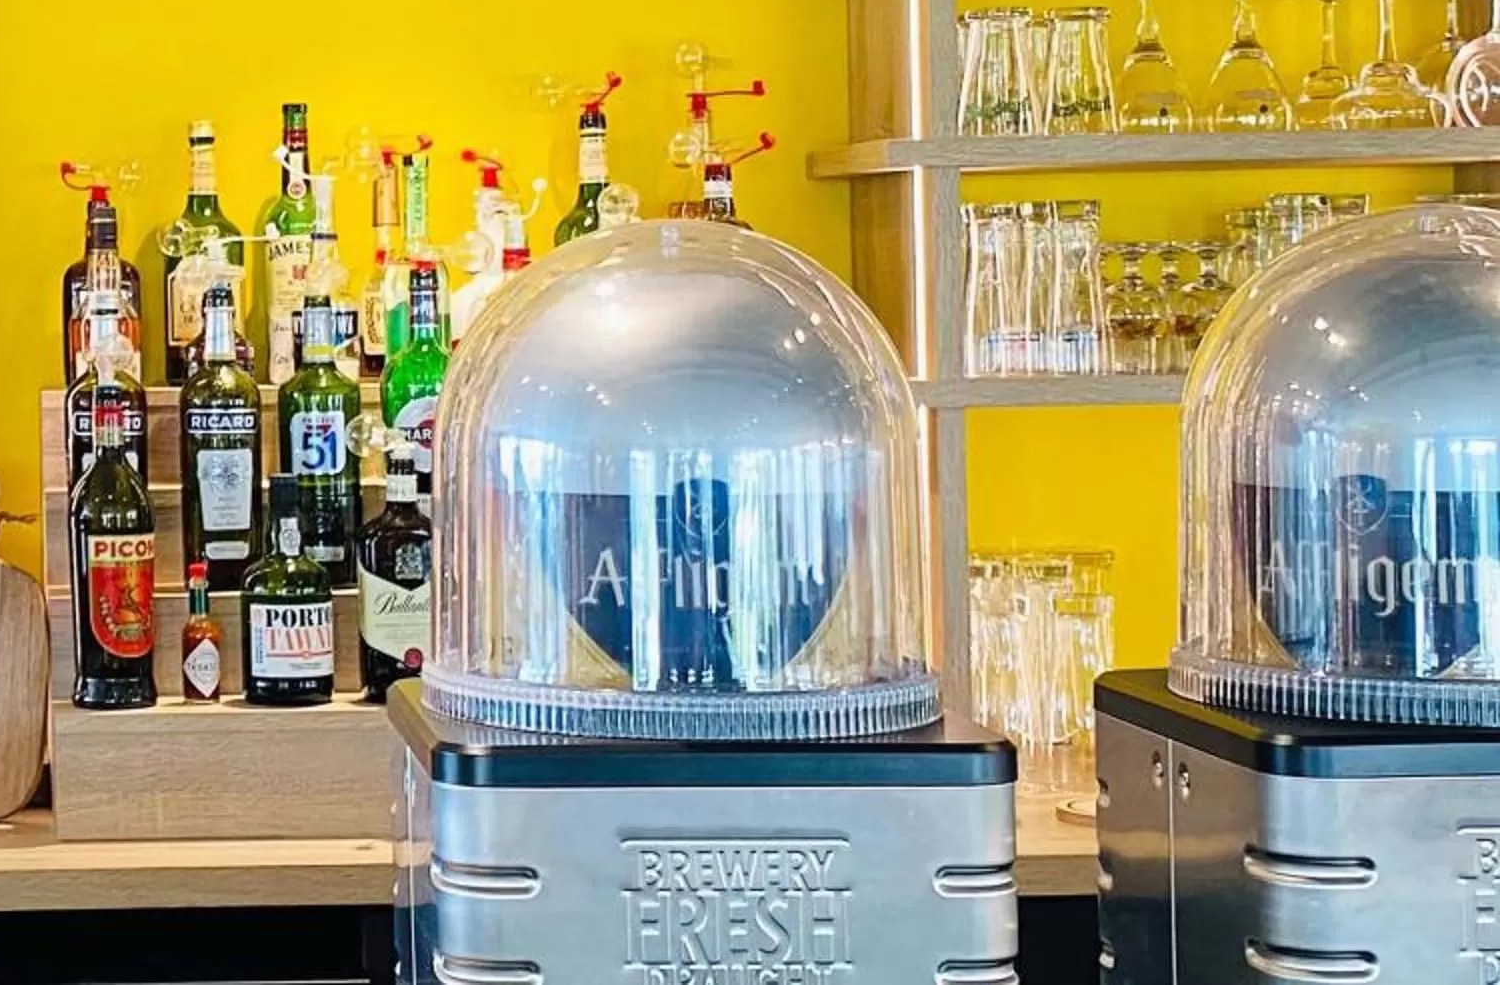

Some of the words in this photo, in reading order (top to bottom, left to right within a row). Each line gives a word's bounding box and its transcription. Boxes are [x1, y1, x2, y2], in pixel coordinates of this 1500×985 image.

[268, 241, 313, 261] JAMES
[191, 416, 255, 429] RICARD
[302, 431, 337, 470] 51
[266, 627, 332, 650] TAWN
[639, 849, 834, 891] BREWERY
[622, 891, 853, 966] FRESH
